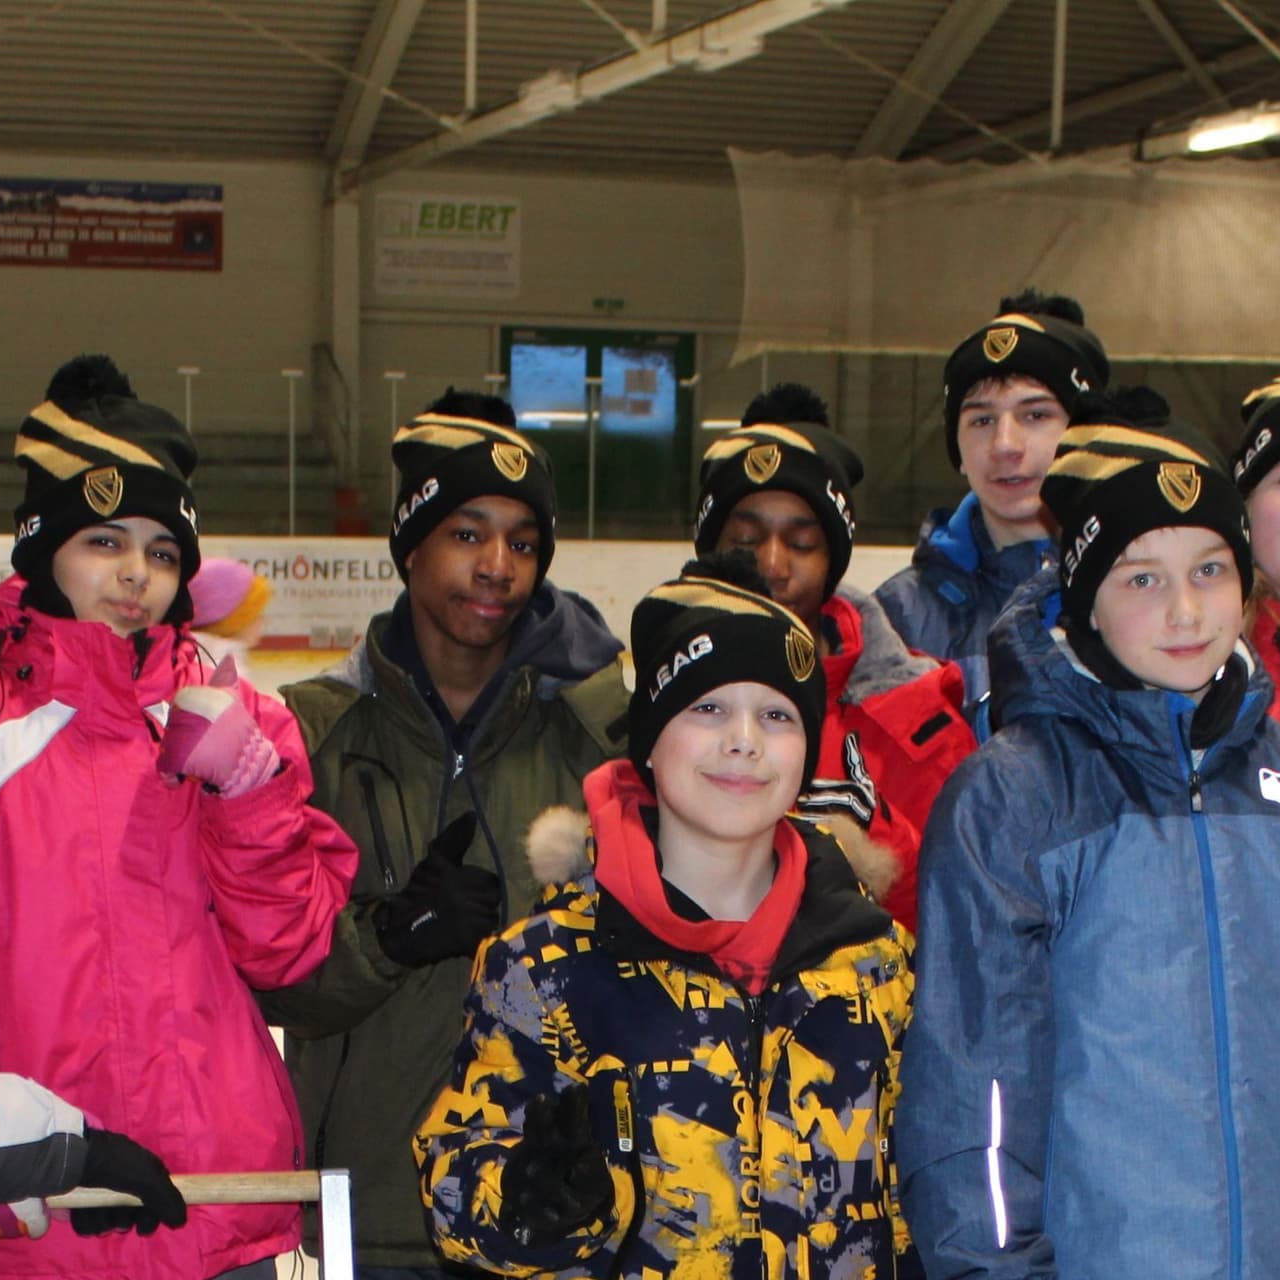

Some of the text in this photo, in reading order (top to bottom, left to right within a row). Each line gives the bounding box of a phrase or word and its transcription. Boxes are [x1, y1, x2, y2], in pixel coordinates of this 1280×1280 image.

[419, 203, 516, 232] EBERT
[392, 477, 440, 537] LEAG
[648, 632, 714, 702] LEAG
